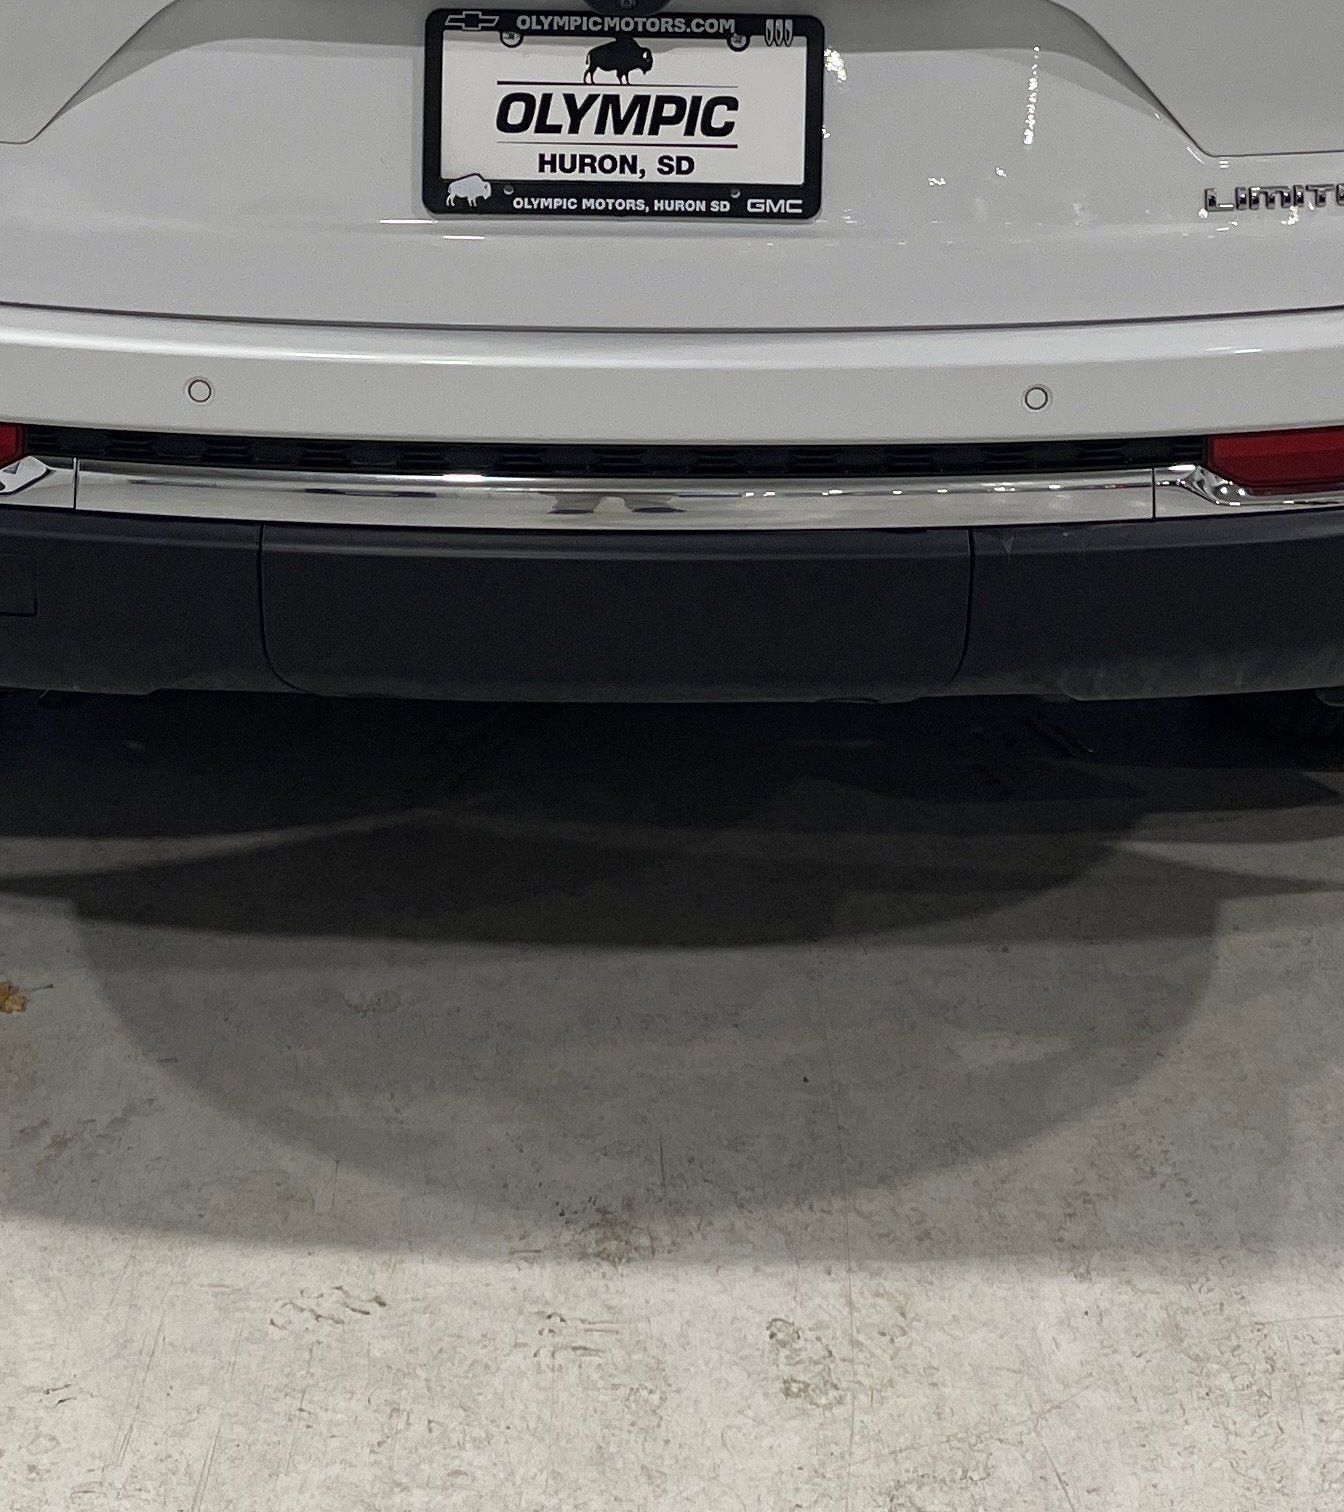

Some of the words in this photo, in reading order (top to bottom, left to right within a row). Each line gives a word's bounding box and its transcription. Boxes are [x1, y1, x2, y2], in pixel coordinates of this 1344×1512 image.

[516, 14, 736, 33] OLYMPICMOTORS.COM
[495, 92, 739, 137] OLYMPIC
[537, 153, 646, 179] HURON,
[656, 155, 695, 176] SD
[512, 197, 577, 211] OLYMPIC
[581, 197, 650, 213] MOTORS,
[654, 199, 707, 212] HURON
[710, 199, 731, 213] SD
[746, 198, 803, 214] GMC
